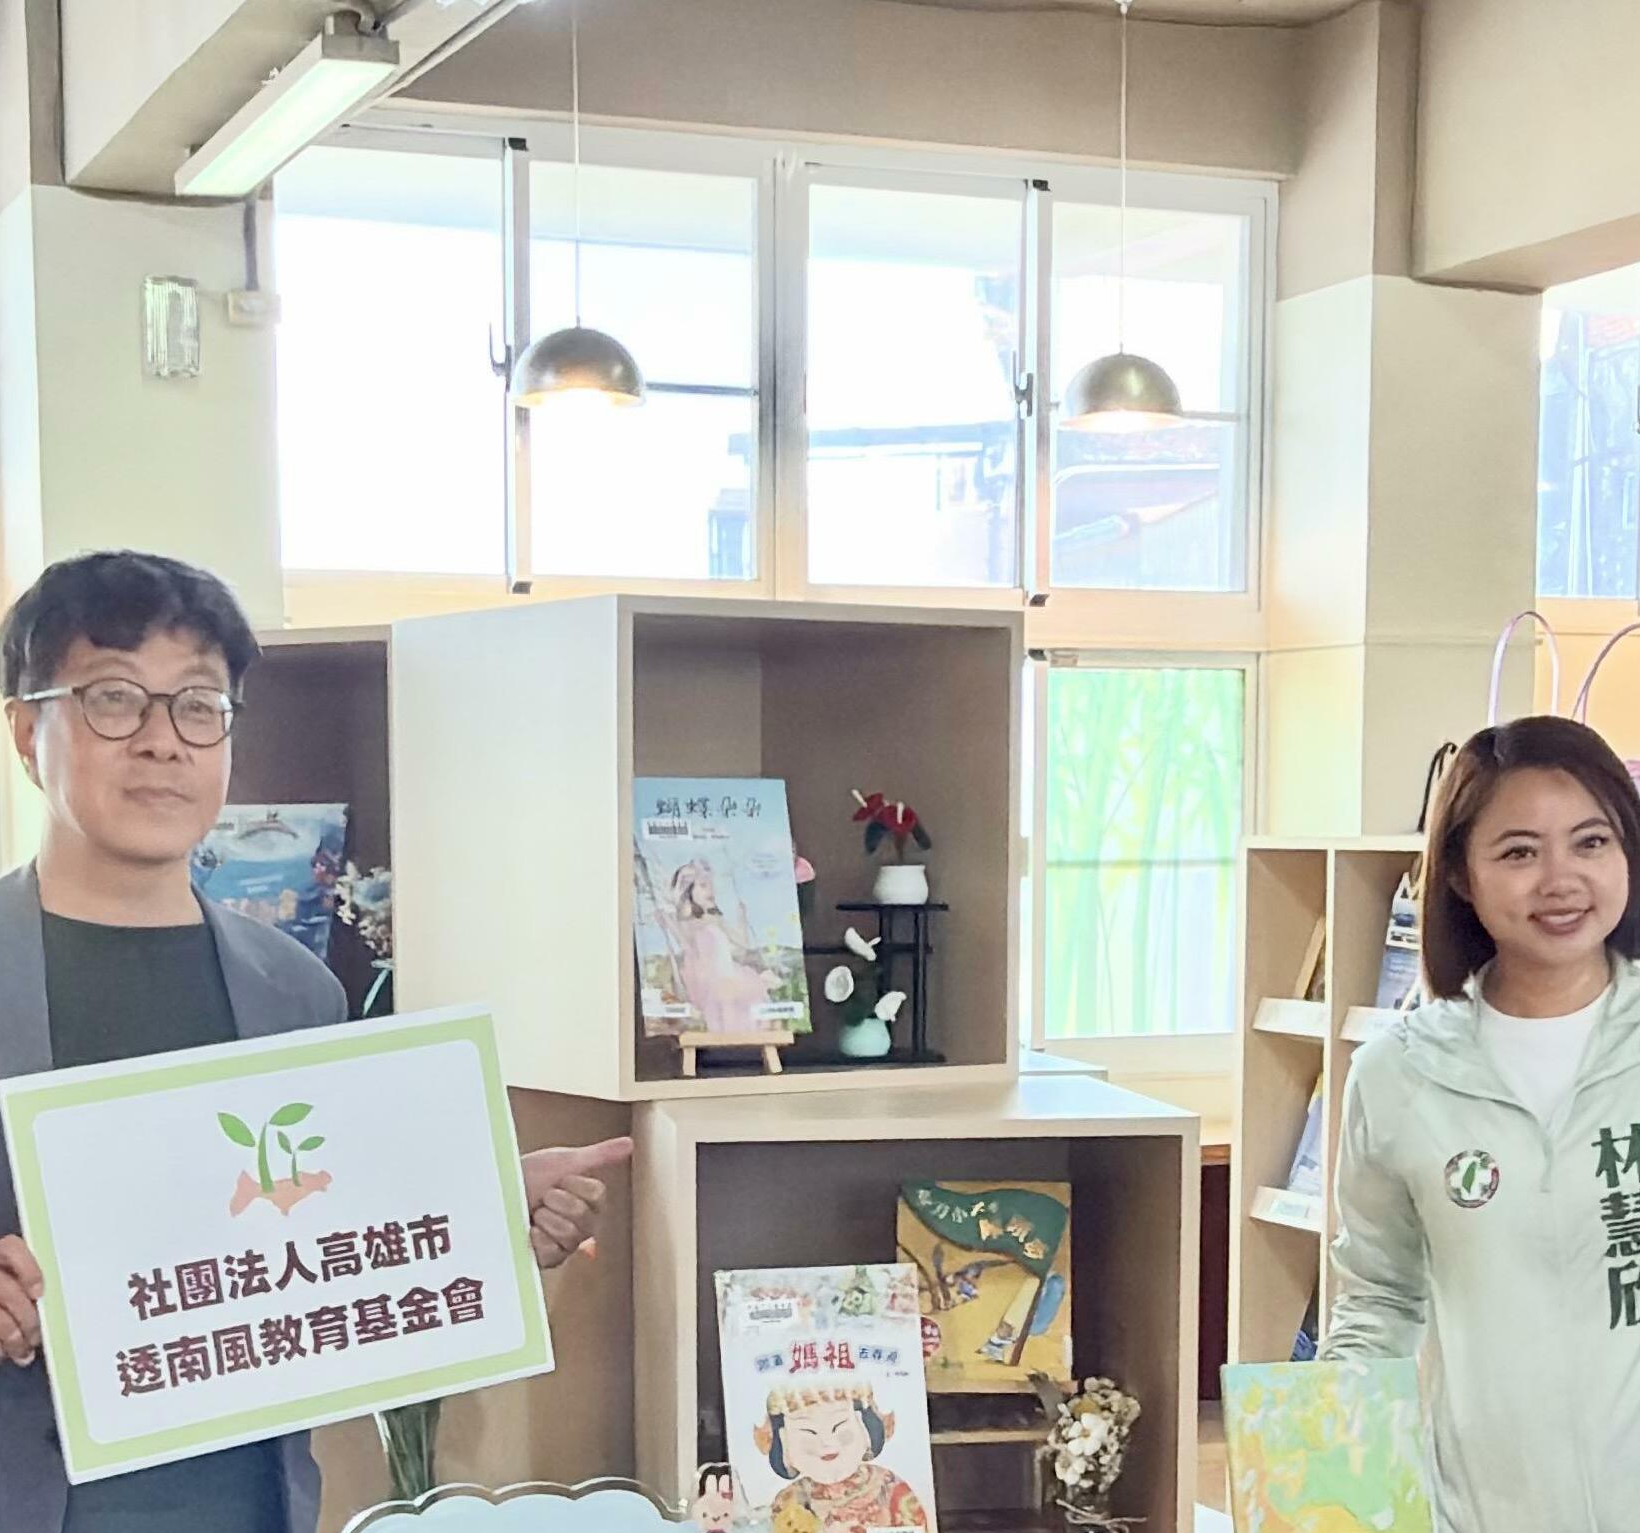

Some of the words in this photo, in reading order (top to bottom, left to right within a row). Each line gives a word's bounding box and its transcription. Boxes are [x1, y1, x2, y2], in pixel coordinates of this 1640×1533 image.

[127, 1214, 453, 1322] 社團法人高雄市
[115, 1276, 486, 1397] 透南風教育基金會
[788, 1339, 856, 1374] 媽祖
